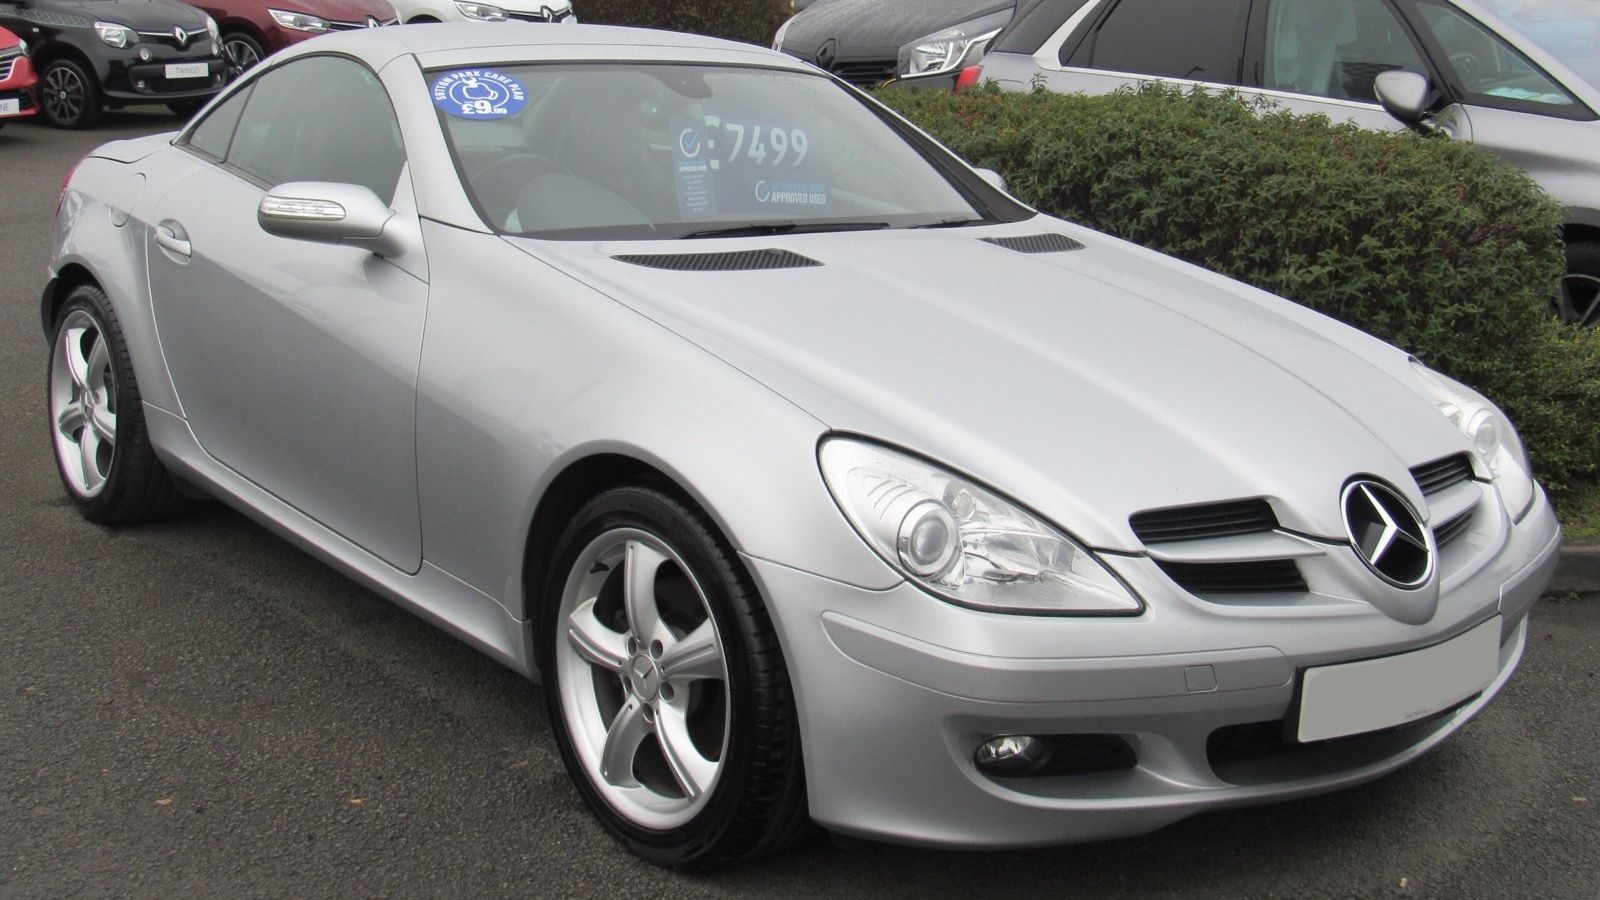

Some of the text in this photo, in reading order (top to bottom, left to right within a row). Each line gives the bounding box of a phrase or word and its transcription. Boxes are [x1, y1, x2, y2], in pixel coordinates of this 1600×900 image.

[175, 67, 200, 75] TWINGO
[435, 77, 454, 100] SUTTON
[450, 70, 481, 80] PARK
[484, 71, 512, 85] CARE
[771, 192, 826, 205] APPROVED USED
